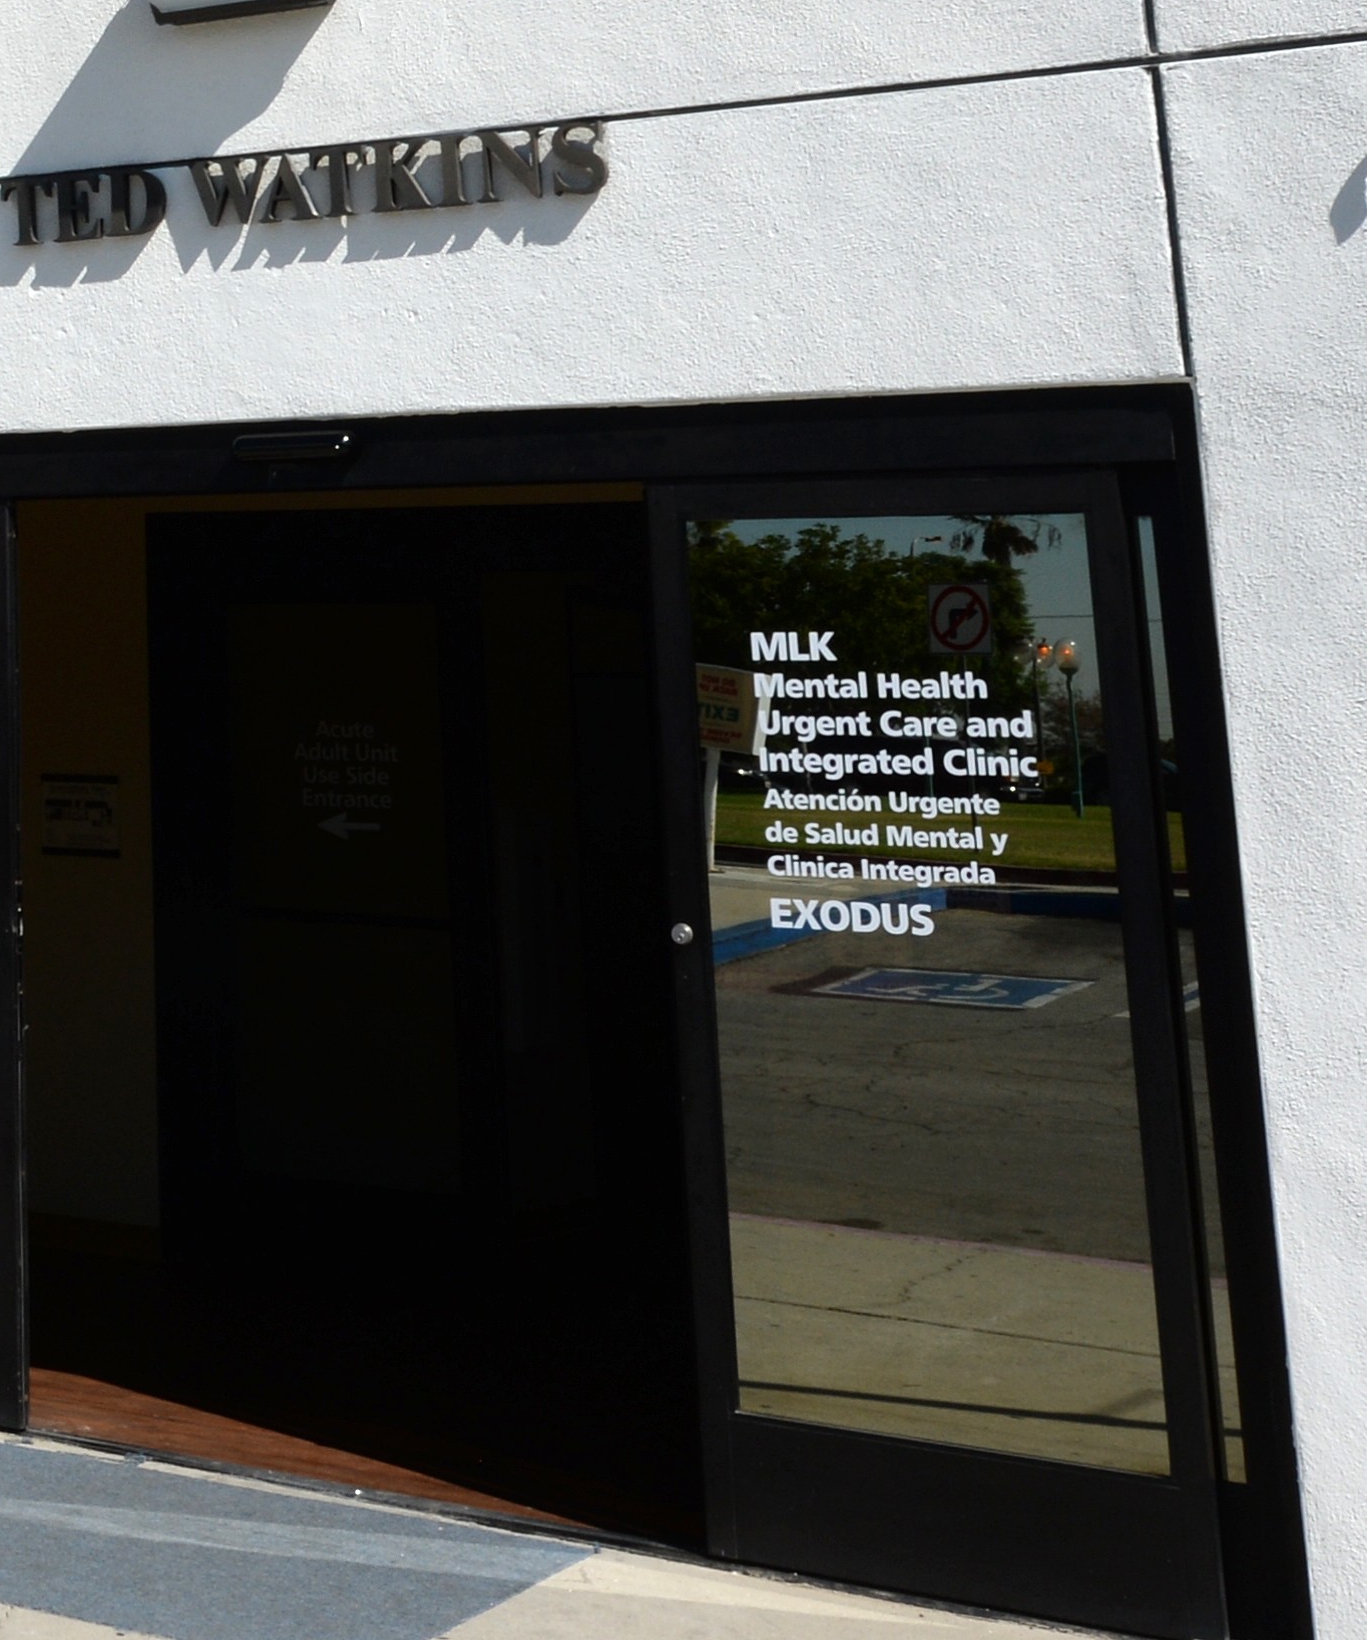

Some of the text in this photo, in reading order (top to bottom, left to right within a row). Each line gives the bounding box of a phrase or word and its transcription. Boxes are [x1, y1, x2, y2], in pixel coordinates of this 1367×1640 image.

[0, 121, 609, 247] TED WATKINS
[750, 631, 836, 662] MLK
[753, 671, 988, 700] Mental Health
[315, 719, 375, 740] Acute
[758, 709, 872, 742] Urgent
[880, 710, 958, 738] Care
[967, 710, 1033, 738] and
[293, 741, 399, 764] Adult Unit
[758, 747, 1038, 780] Integrated Clinic
[303, 765, 390, 787] Use Side
[301, 788, 393, 810] Entrance
[763, 788, 1000, 819] Atención Urgente
[765, 821, 1009, 856] de Salud Mental y
[767, 854, 996, 888] Clinica Integrada
[770, 897, 935, 937] EXODUS
